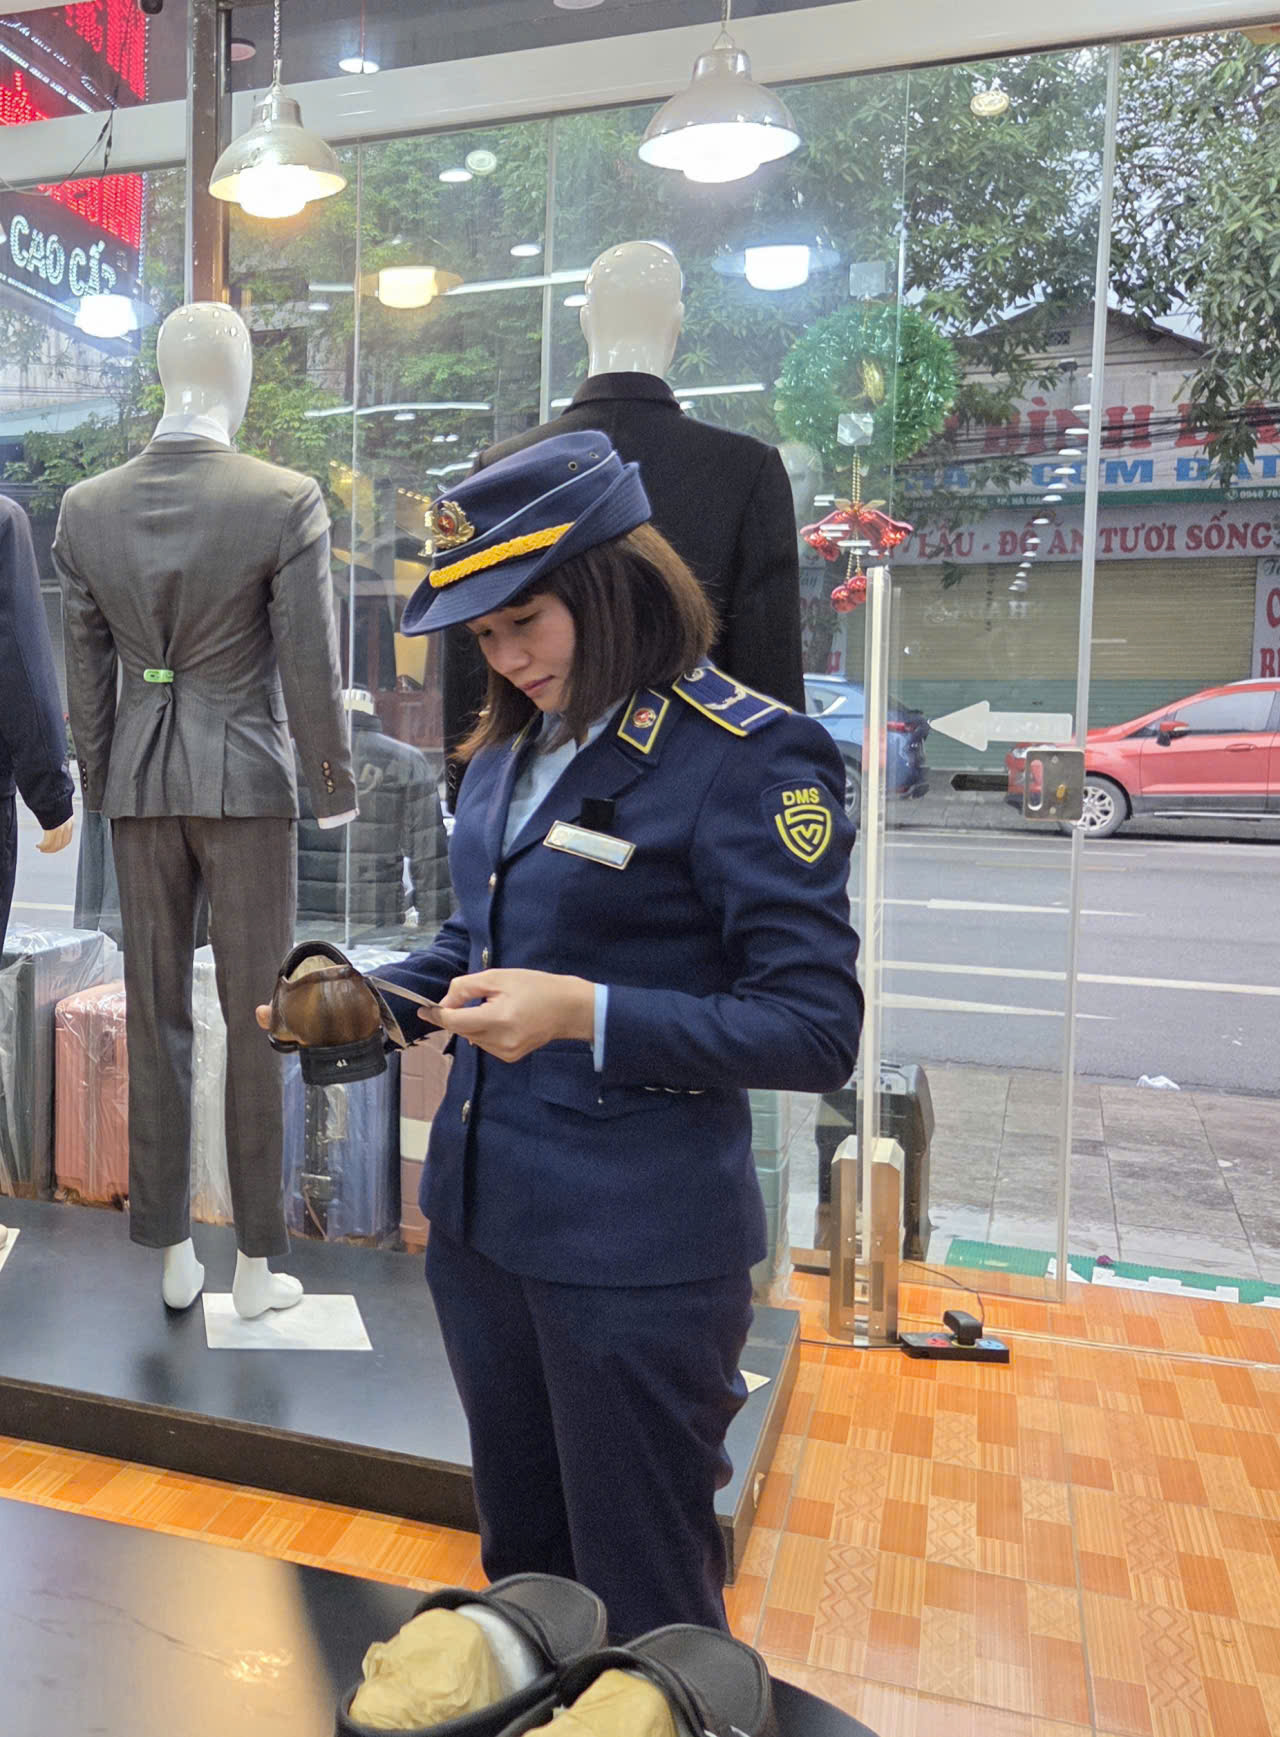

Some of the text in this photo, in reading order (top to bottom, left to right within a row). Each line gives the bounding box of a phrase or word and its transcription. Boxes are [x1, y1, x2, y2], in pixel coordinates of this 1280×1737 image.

[10, 214, 65, 285] CAO
[1099, 522, 1177, 554] TƯƠI
[1185, 510, 1273, 551] SỐNG
[781, 787, 820, 806] DMS
